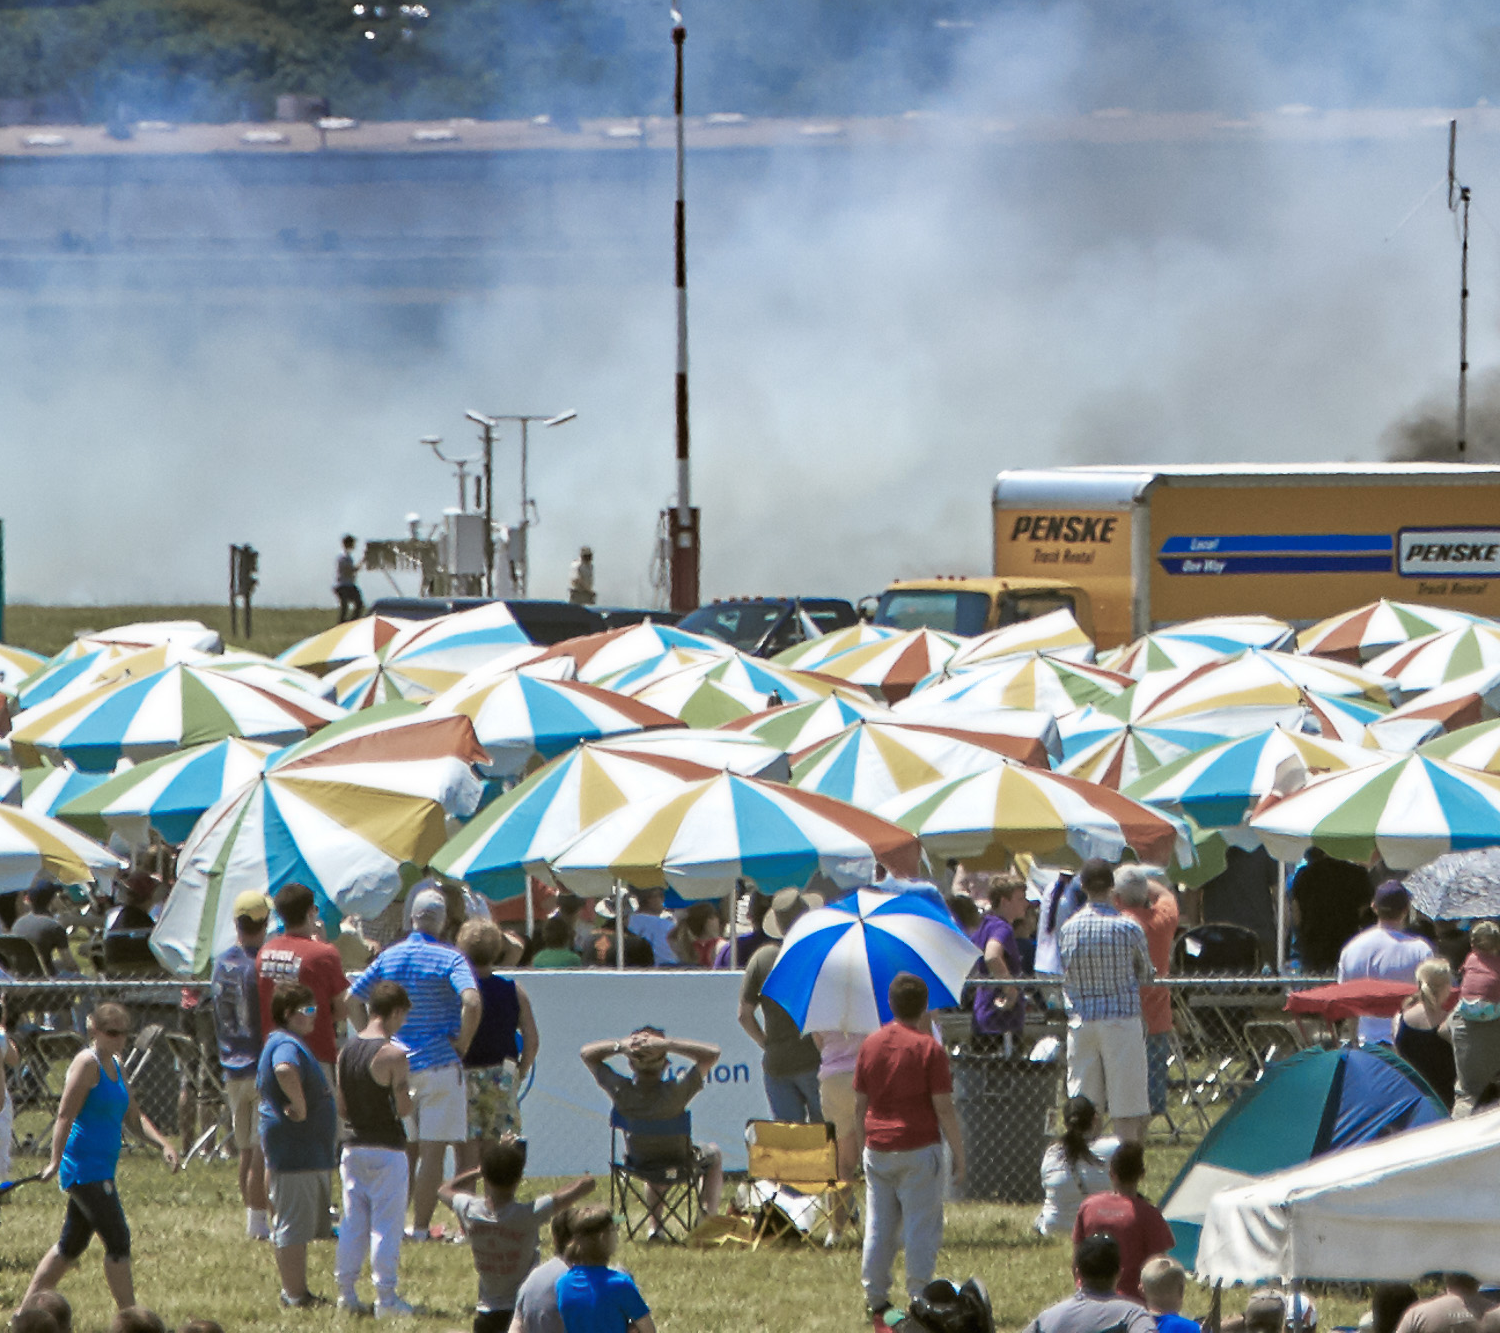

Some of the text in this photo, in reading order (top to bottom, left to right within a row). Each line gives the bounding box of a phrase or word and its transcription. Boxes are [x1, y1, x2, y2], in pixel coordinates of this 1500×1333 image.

[1011, 515, 1118, 543] PENSKE
[1033, 548, 1096, 565] Truck Rental
[1406, 544, 1500, 562] PENSKE
